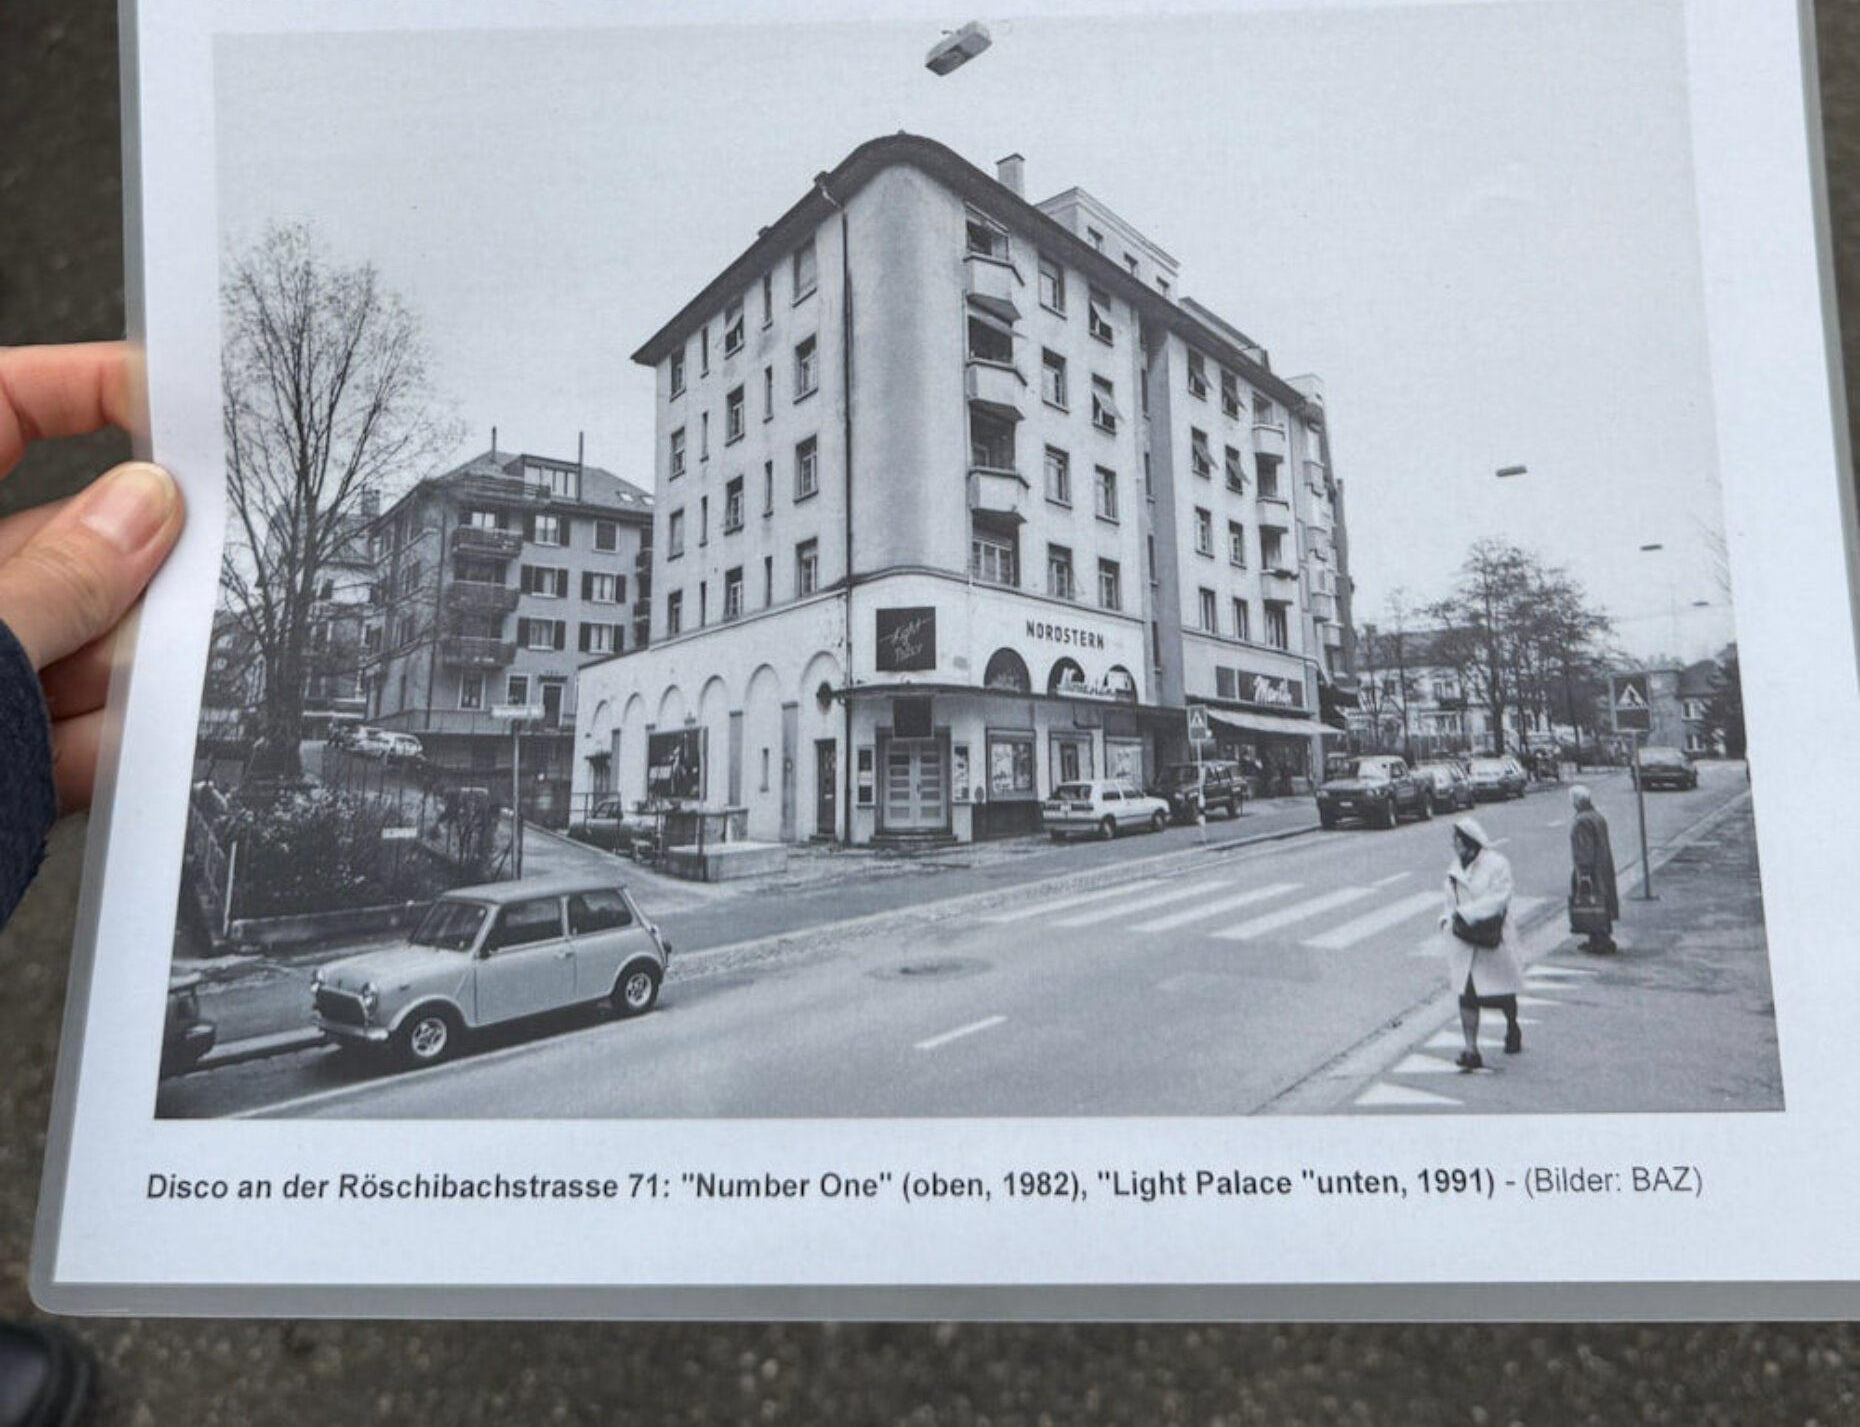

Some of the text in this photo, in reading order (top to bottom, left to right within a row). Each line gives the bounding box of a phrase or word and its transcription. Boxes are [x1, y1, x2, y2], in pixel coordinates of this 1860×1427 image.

[1026, 619, 1105, 651] NORDSTERN
[147, 1173, 229, 1200] Disco
[237, 1179, 273, 1200] an
[283, 1172, 330, 1200] der
[338, 1172, 619, 1200] Röschibachstrasse
[628, 1172, 671, 1199] 71:
[681, 1171, 811, 1199] "Number
[819, 1171, 893, 1198] One"
[902, 1170, 992, 1204] (oben,
[1003, 1170, 1088, 1203] 1982),
[1097, 1170, 1188, 1203] "Light
[1195, 1169, 1293, 1197] Palace
[1301, 1168, 1408, 1201] "unten,
[1417, 1168, 1495, 1200] 1991)
[1524, 1167, 1622, 1201] (Bilder:
[1631, 1166, 1703, 1199] BAZ)
